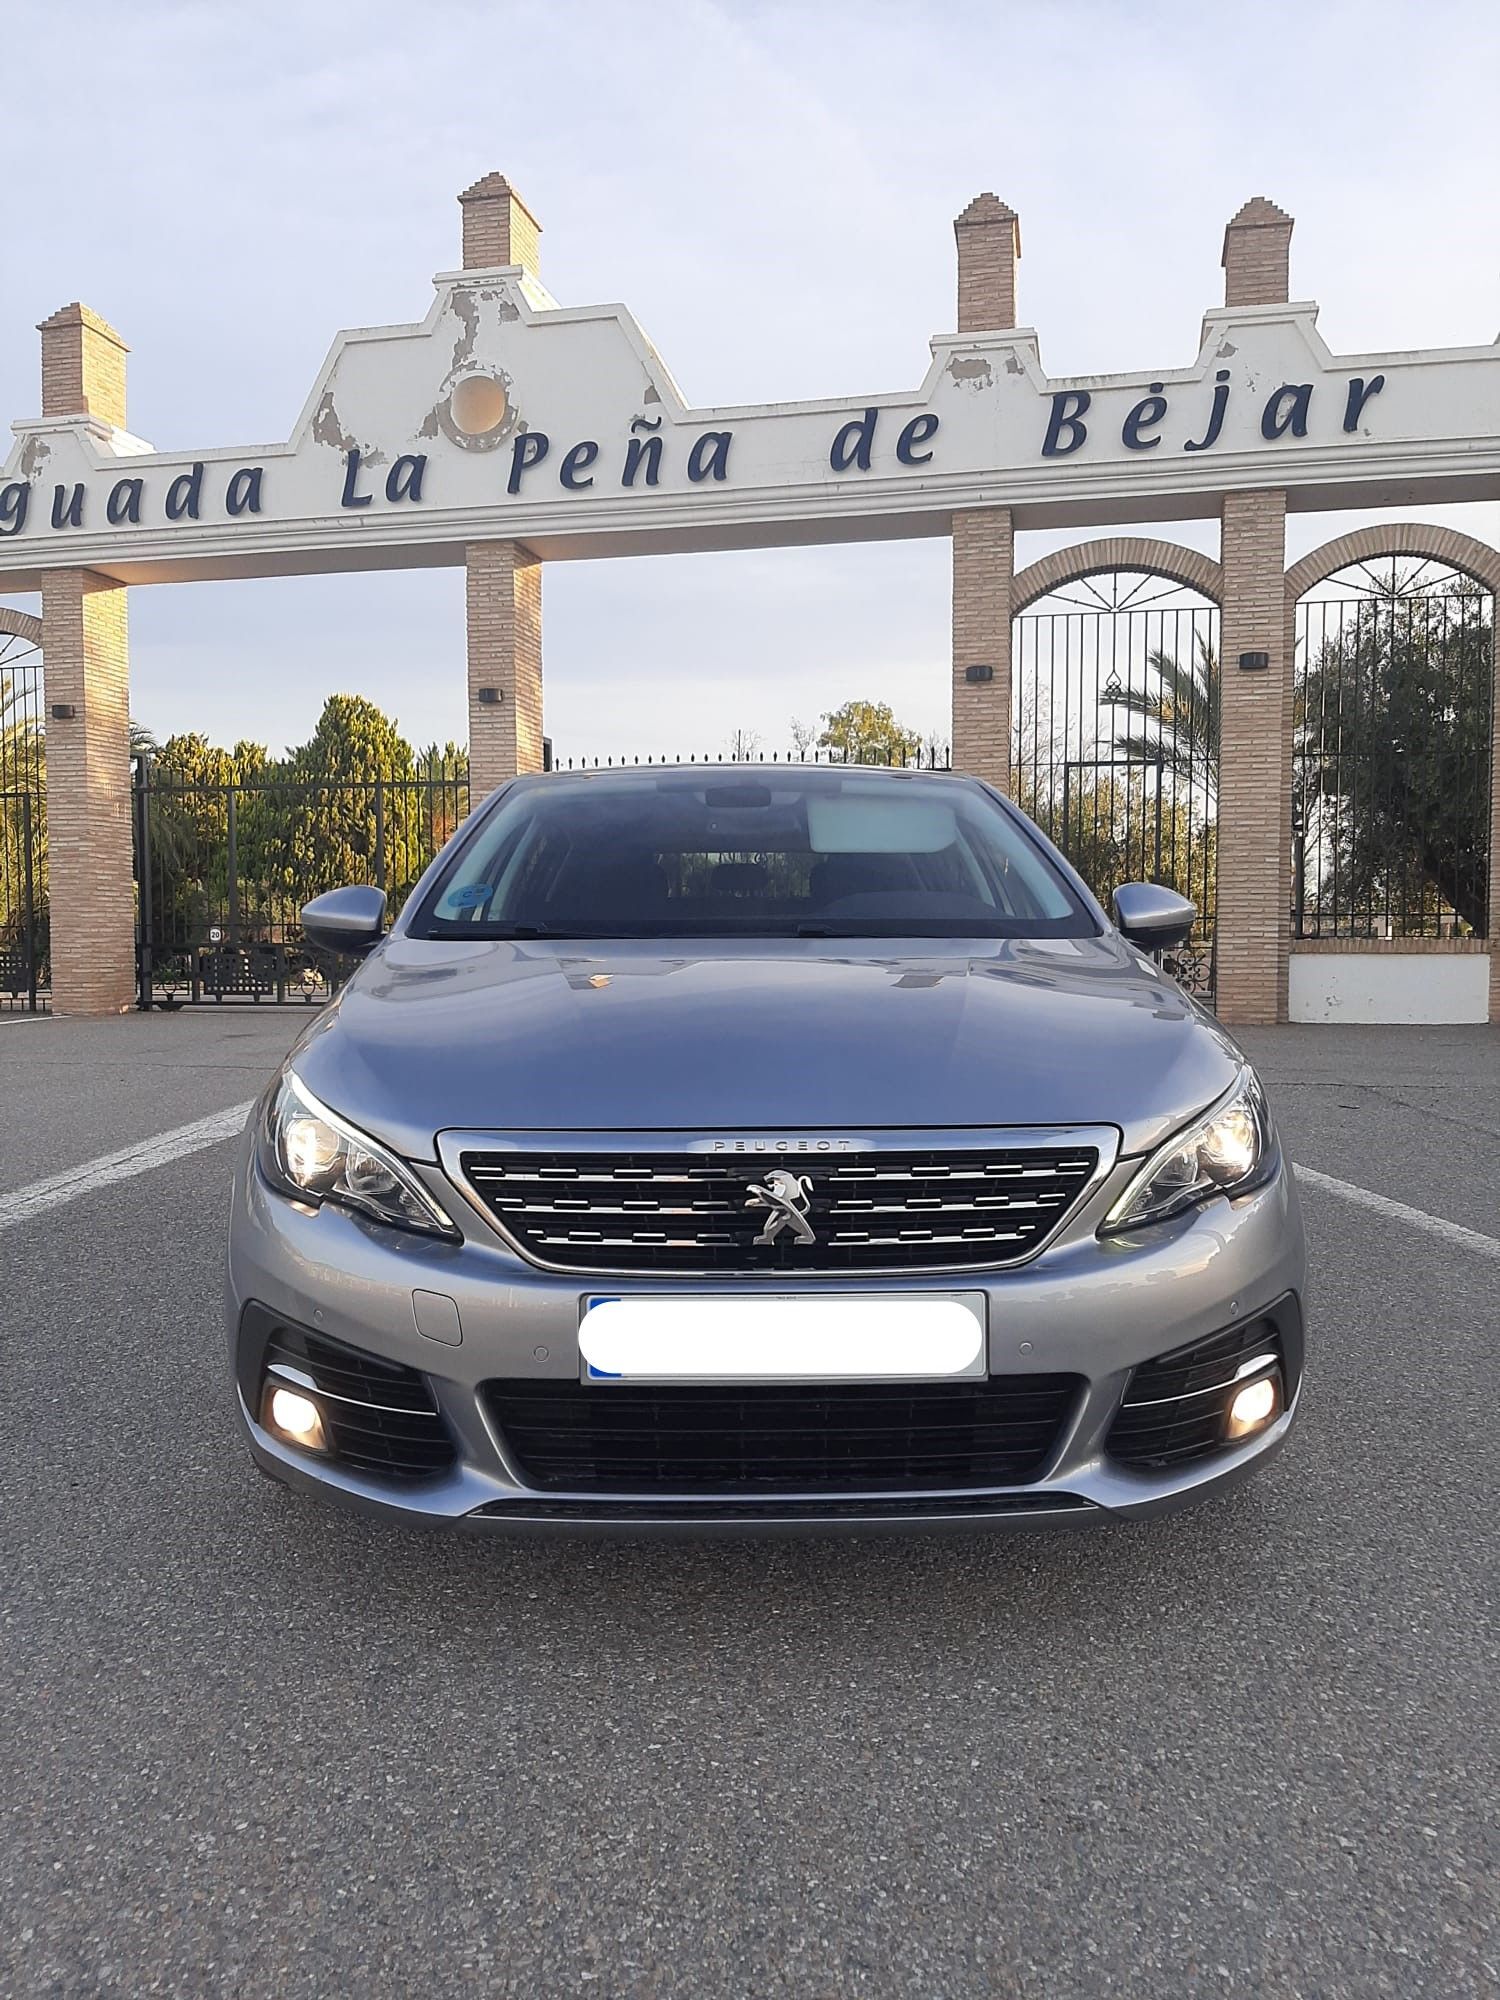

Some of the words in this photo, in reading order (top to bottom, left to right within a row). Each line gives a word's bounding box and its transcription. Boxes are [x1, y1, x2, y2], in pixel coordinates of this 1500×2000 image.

[0, 463, 264, 536] guada
[341, 449, 428, 508] La
[506, 416, 733, 495] Peña
[829, 407, 940, 472] de
[713, 1140, 851, 1151] PEUGEOT
